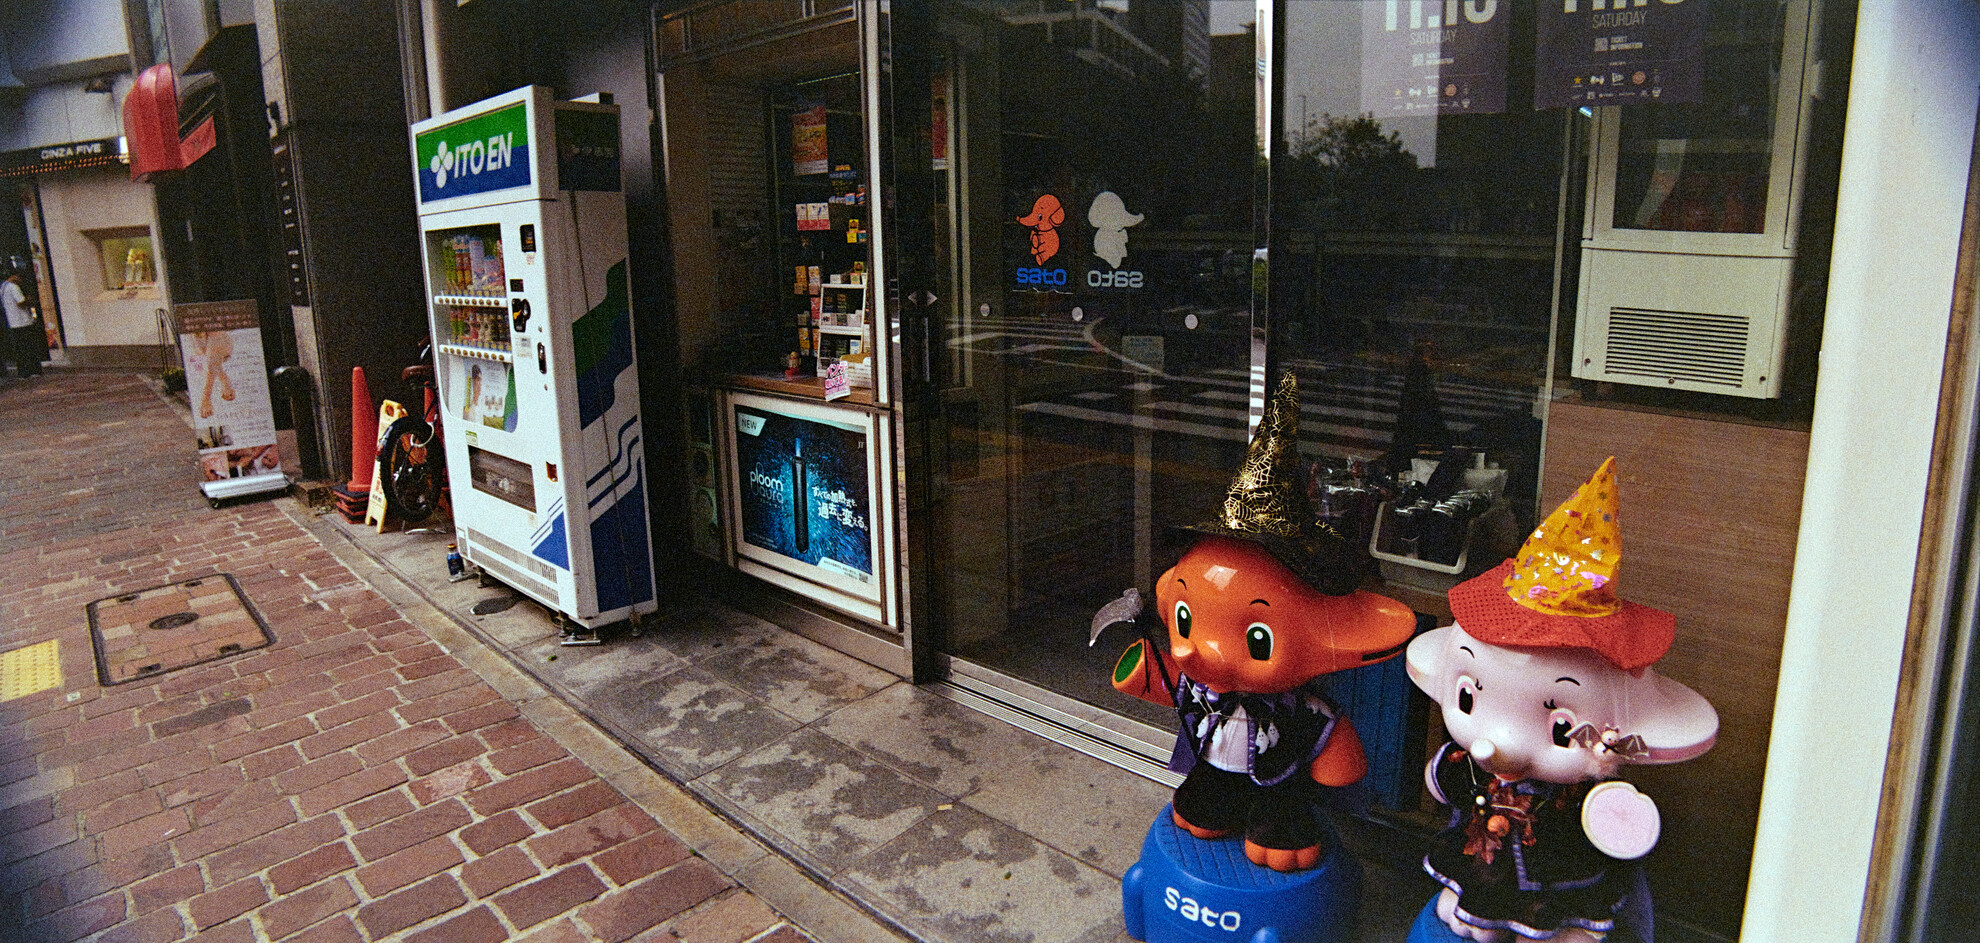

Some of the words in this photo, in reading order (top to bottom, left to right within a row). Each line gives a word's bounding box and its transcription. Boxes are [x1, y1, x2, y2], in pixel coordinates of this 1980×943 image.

[1592, 11, 1648, 29] SATURDAY
[1409, 29, 1458, 45] SATURDAY
[40, 146, 73, 160] GINZA
[76, 143, 102, 155] FIVE
[454, 140, 485, 178] ITO
[486, 131, 513, 172] EN
[1016, 267, 1067, 286] sato
[741, 417, 757, 430] NEW
[857, 440, 865, 449] JT
[750, 462, 784, 495] ploom
[817, 501, 868, 532] 過去に変える。
[1164, 887, 1241, 932] sato
